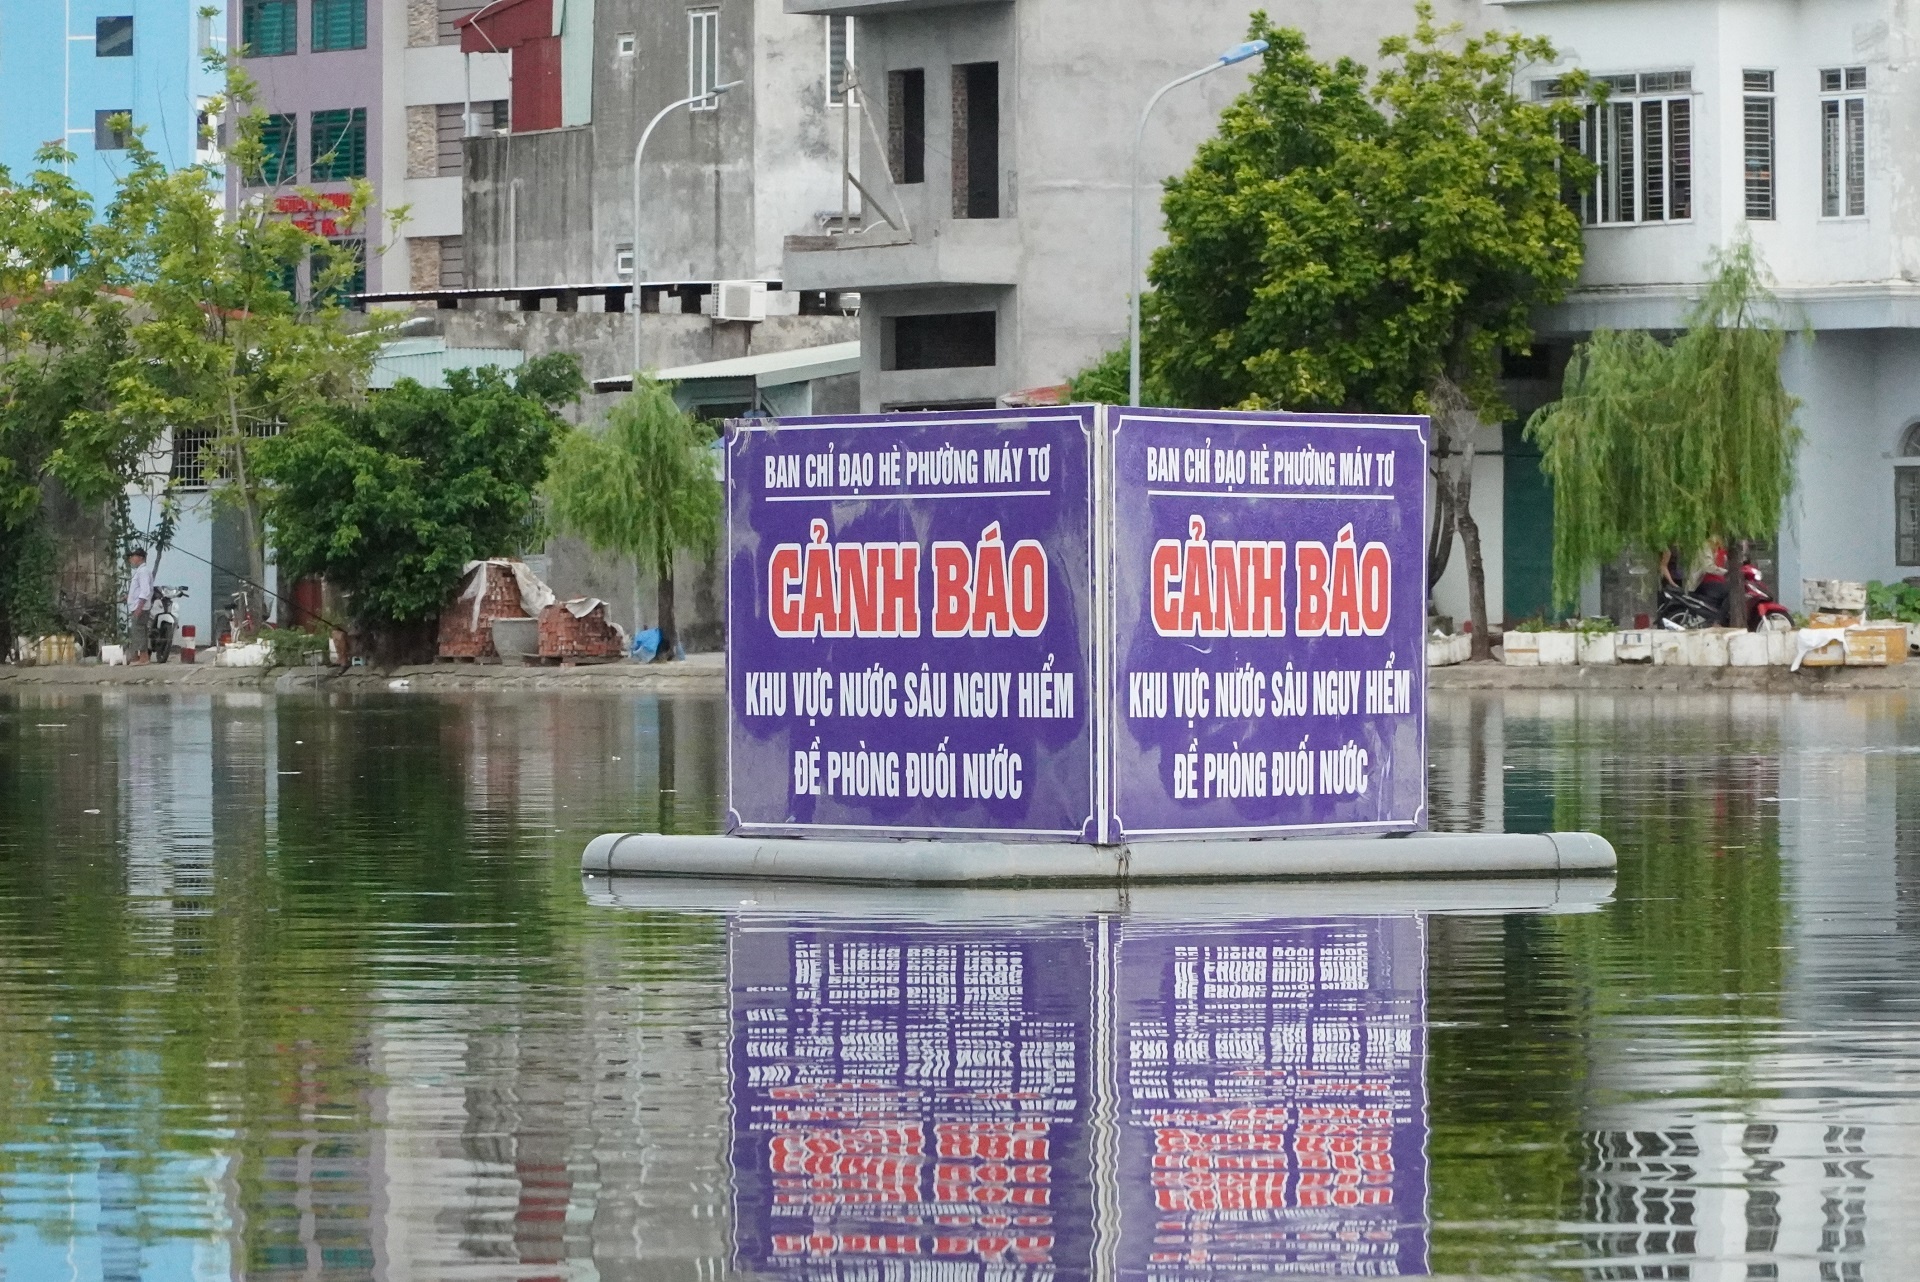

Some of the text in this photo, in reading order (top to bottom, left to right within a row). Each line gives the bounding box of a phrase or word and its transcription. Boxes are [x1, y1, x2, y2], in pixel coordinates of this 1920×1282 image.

[766, 441, 1050, 494] BAN CHỈ ĐẠO HÈ PHƯỜNG MÁY TƠ
[1147, 438, 1395, 491] BAN CHỈ ĐẠO HÈ PHƯỜNG MÁY TƠ
[769, 518, 1048, 638] CẢNH BÁO
[1151, 514, 1391, 637] CẢNH BÁO
[746, 653, 1074, 726] KHU VỰC NƯỚC SÂU NGUY HIỂM
[1129, 651, 1410, 728] KHU VỰC NƯỚC SÂU NGUY HIỂM
[794, 736, 1022, 799] ĐỀ PHÒNG ĐUỐI NƯỚC
[1174, 735, 1368, 799] ĐỀ PHÒNG ĐUỐI NƯỚC
